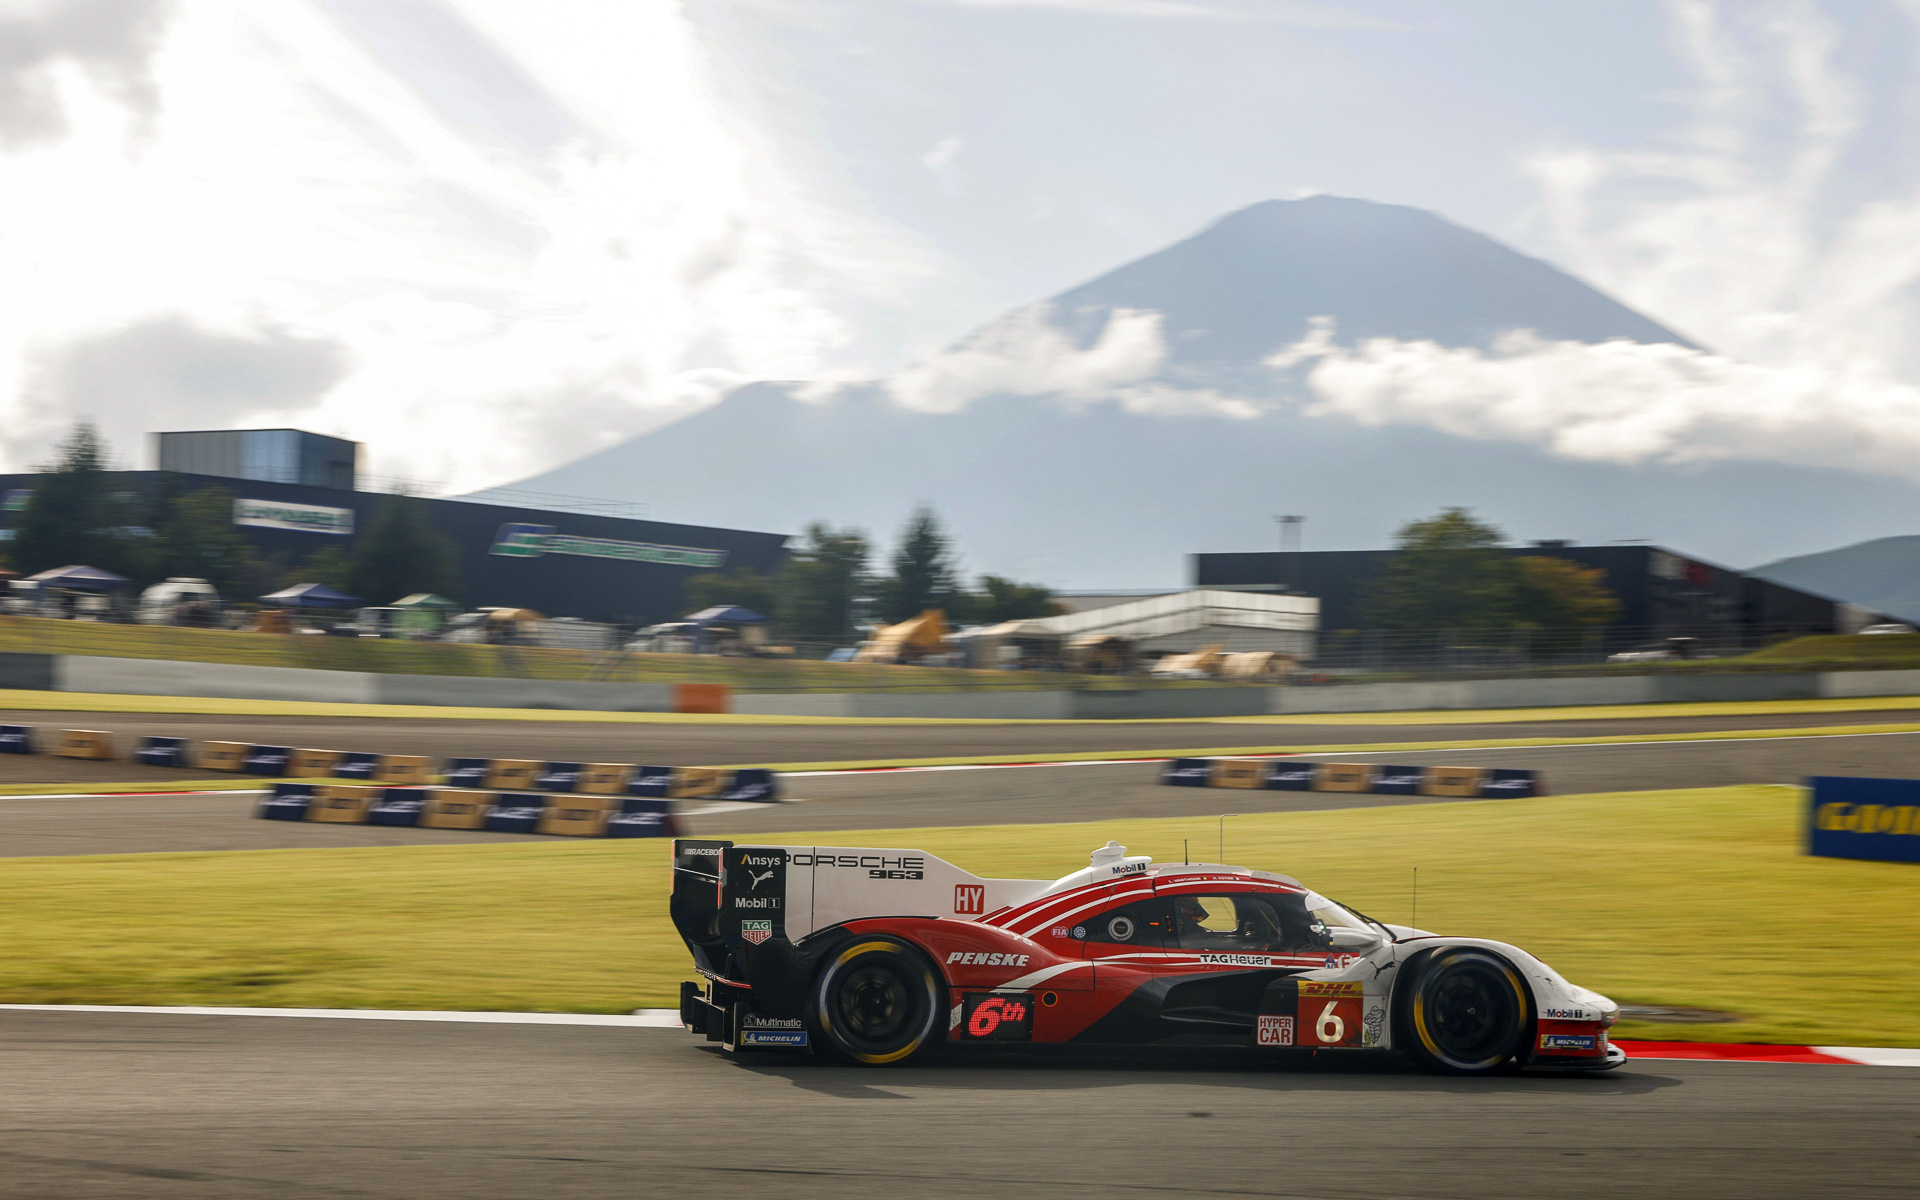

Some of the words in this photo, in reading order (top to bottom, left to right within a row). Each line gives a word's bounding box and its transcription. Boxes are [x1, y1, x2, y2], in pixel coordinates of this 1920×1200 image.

[741, 854, 781, 867] Ansys
[1112, 864, 1136, 874] Mobil
[869, 870, 923, 880] 963
[735, 897, 767, 908] Mobil
[770, 898, 778, 908] 1
[957, 887, 983, 912] HY
[744, 921, 769, 930] TAG
[743, 931, 770, 943] HEUER
[1052, 928, 1067, 936] FIA
[946, 952, 1030, 967] PENSKE
[1304, 983, 1358, 994] DHL
[968, 997, 1026, 1037] 6th
[1547, 1009, 1573, 1018] Mobil
[1575, 1010, 1582, 1018] 1
[756, 1018, 801, 1027] Multimatic
[1260, 1018, 1291, 1028] HYPER
[1316, 1000, 1344, 1043] 6
[1259, 1028, 1291, 1043] CAR
